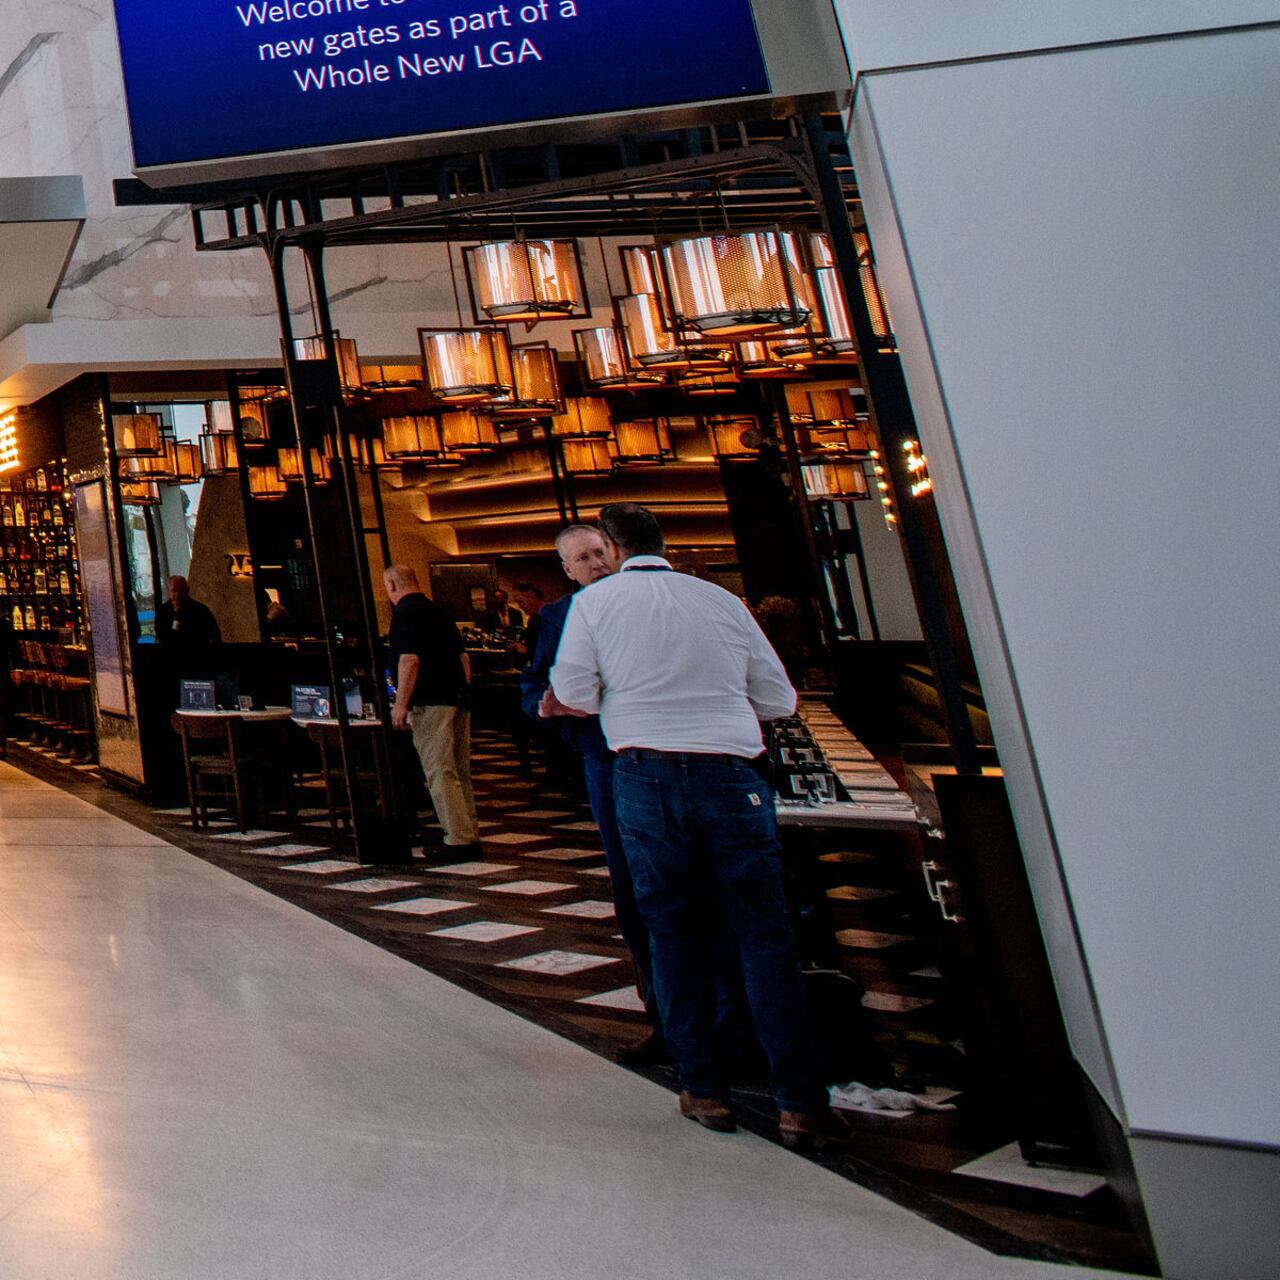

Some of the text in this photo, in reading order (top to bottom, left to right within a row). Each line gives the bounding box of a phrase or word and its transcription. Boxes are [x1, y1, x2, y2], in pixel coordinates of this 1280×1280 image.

[258, 36, 314, 61] new
[323, 22, 400, 56] gates
[409, 18, 441, 40] as
[449, 3, 511, 40] part
[559, 0, 577, 18] a
[293, 37, 543, 93] Whole New LGA
